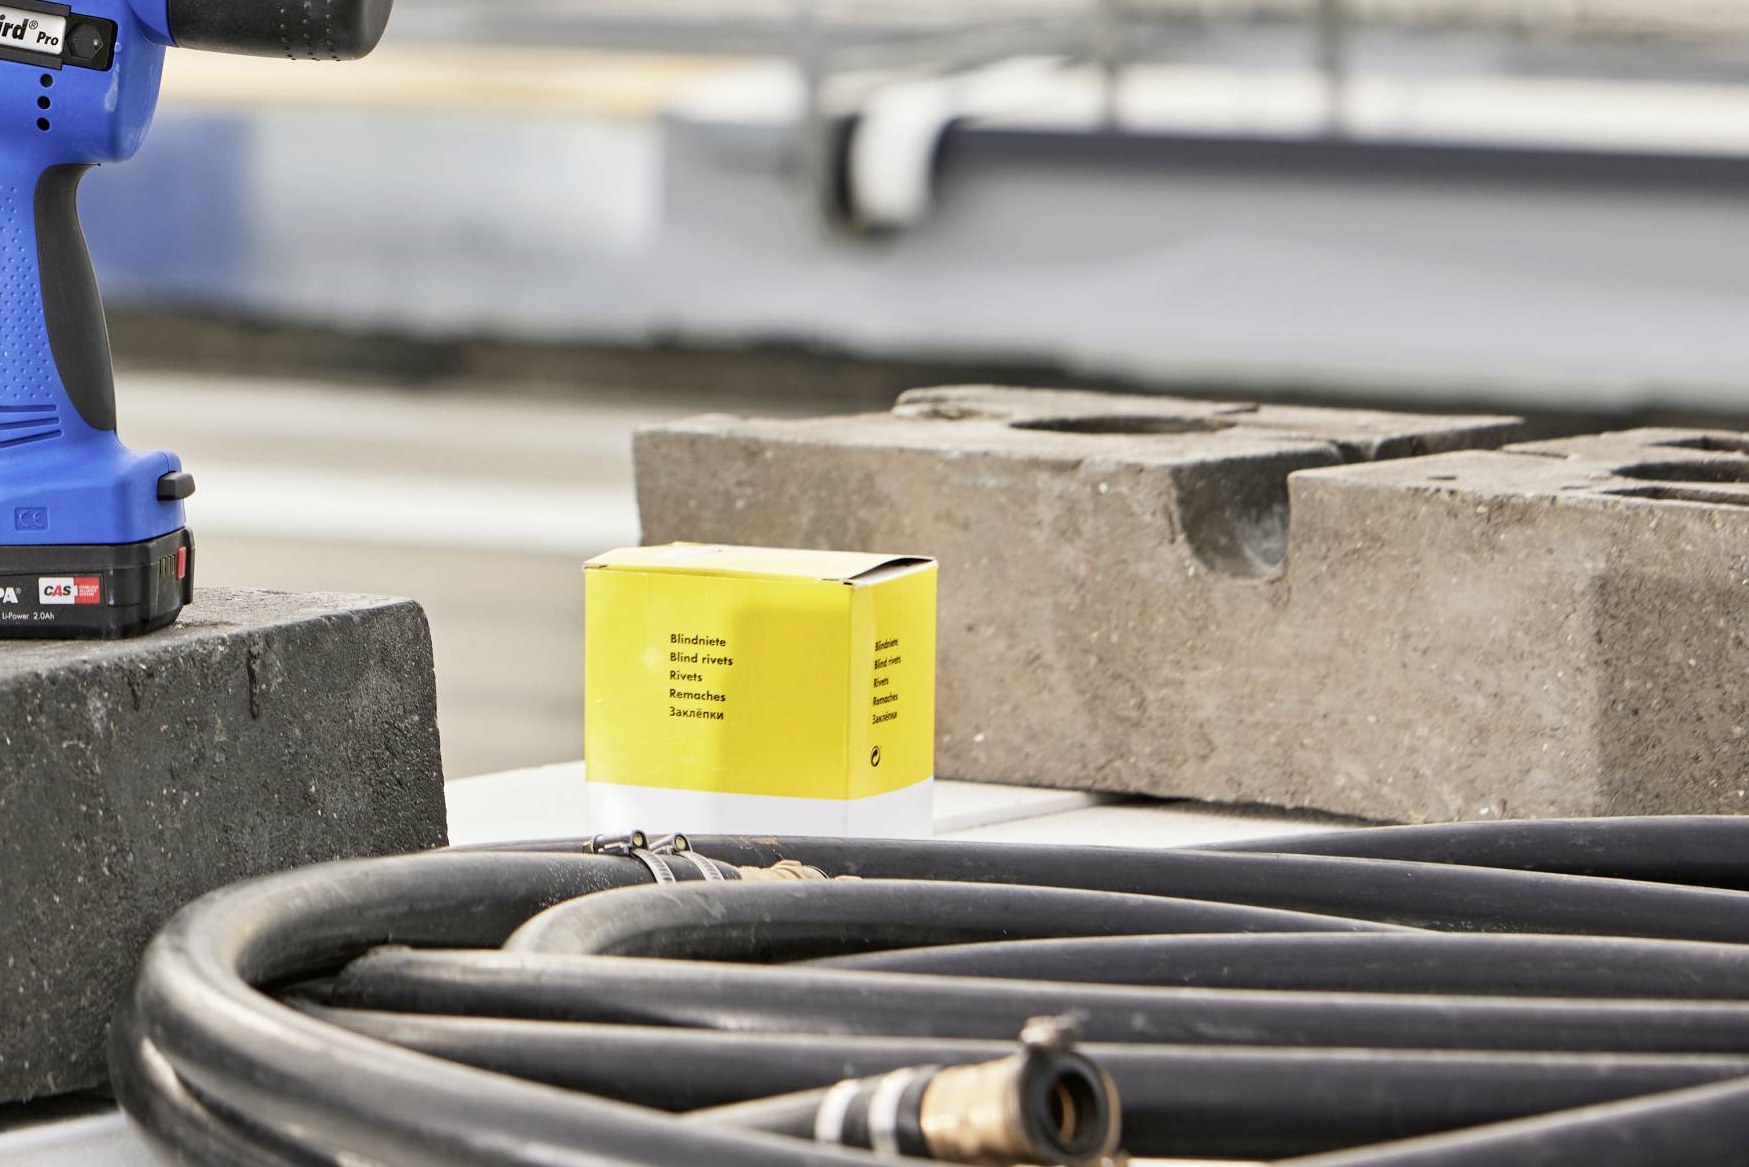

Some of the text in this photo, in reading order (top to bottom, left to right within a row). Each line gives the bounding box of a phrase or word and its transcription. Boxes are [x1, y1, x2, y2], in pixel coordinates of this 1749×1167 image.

[36, 31, 59, 46] Pro
[44, 585, 71, 597] CAS
[2, 612, 29, 620] Li-Power
[33, 612, 55, 620] 2.0Ah
[670, 633, 726, 647] Blindniete
[874, 638, 899, 652] Blindniete
[670, 652, 734, 666] Blind rivets
[874, 655, 901, 670] Blind rivets
[669, 670, 703, 682] Rivets
[873, 677, 889, 688] Rivets
[669, 688, 726, 702] Remaches
[872, 692, 899, 706] Remaches
[669, 706, 724, 720] Заклёпки
